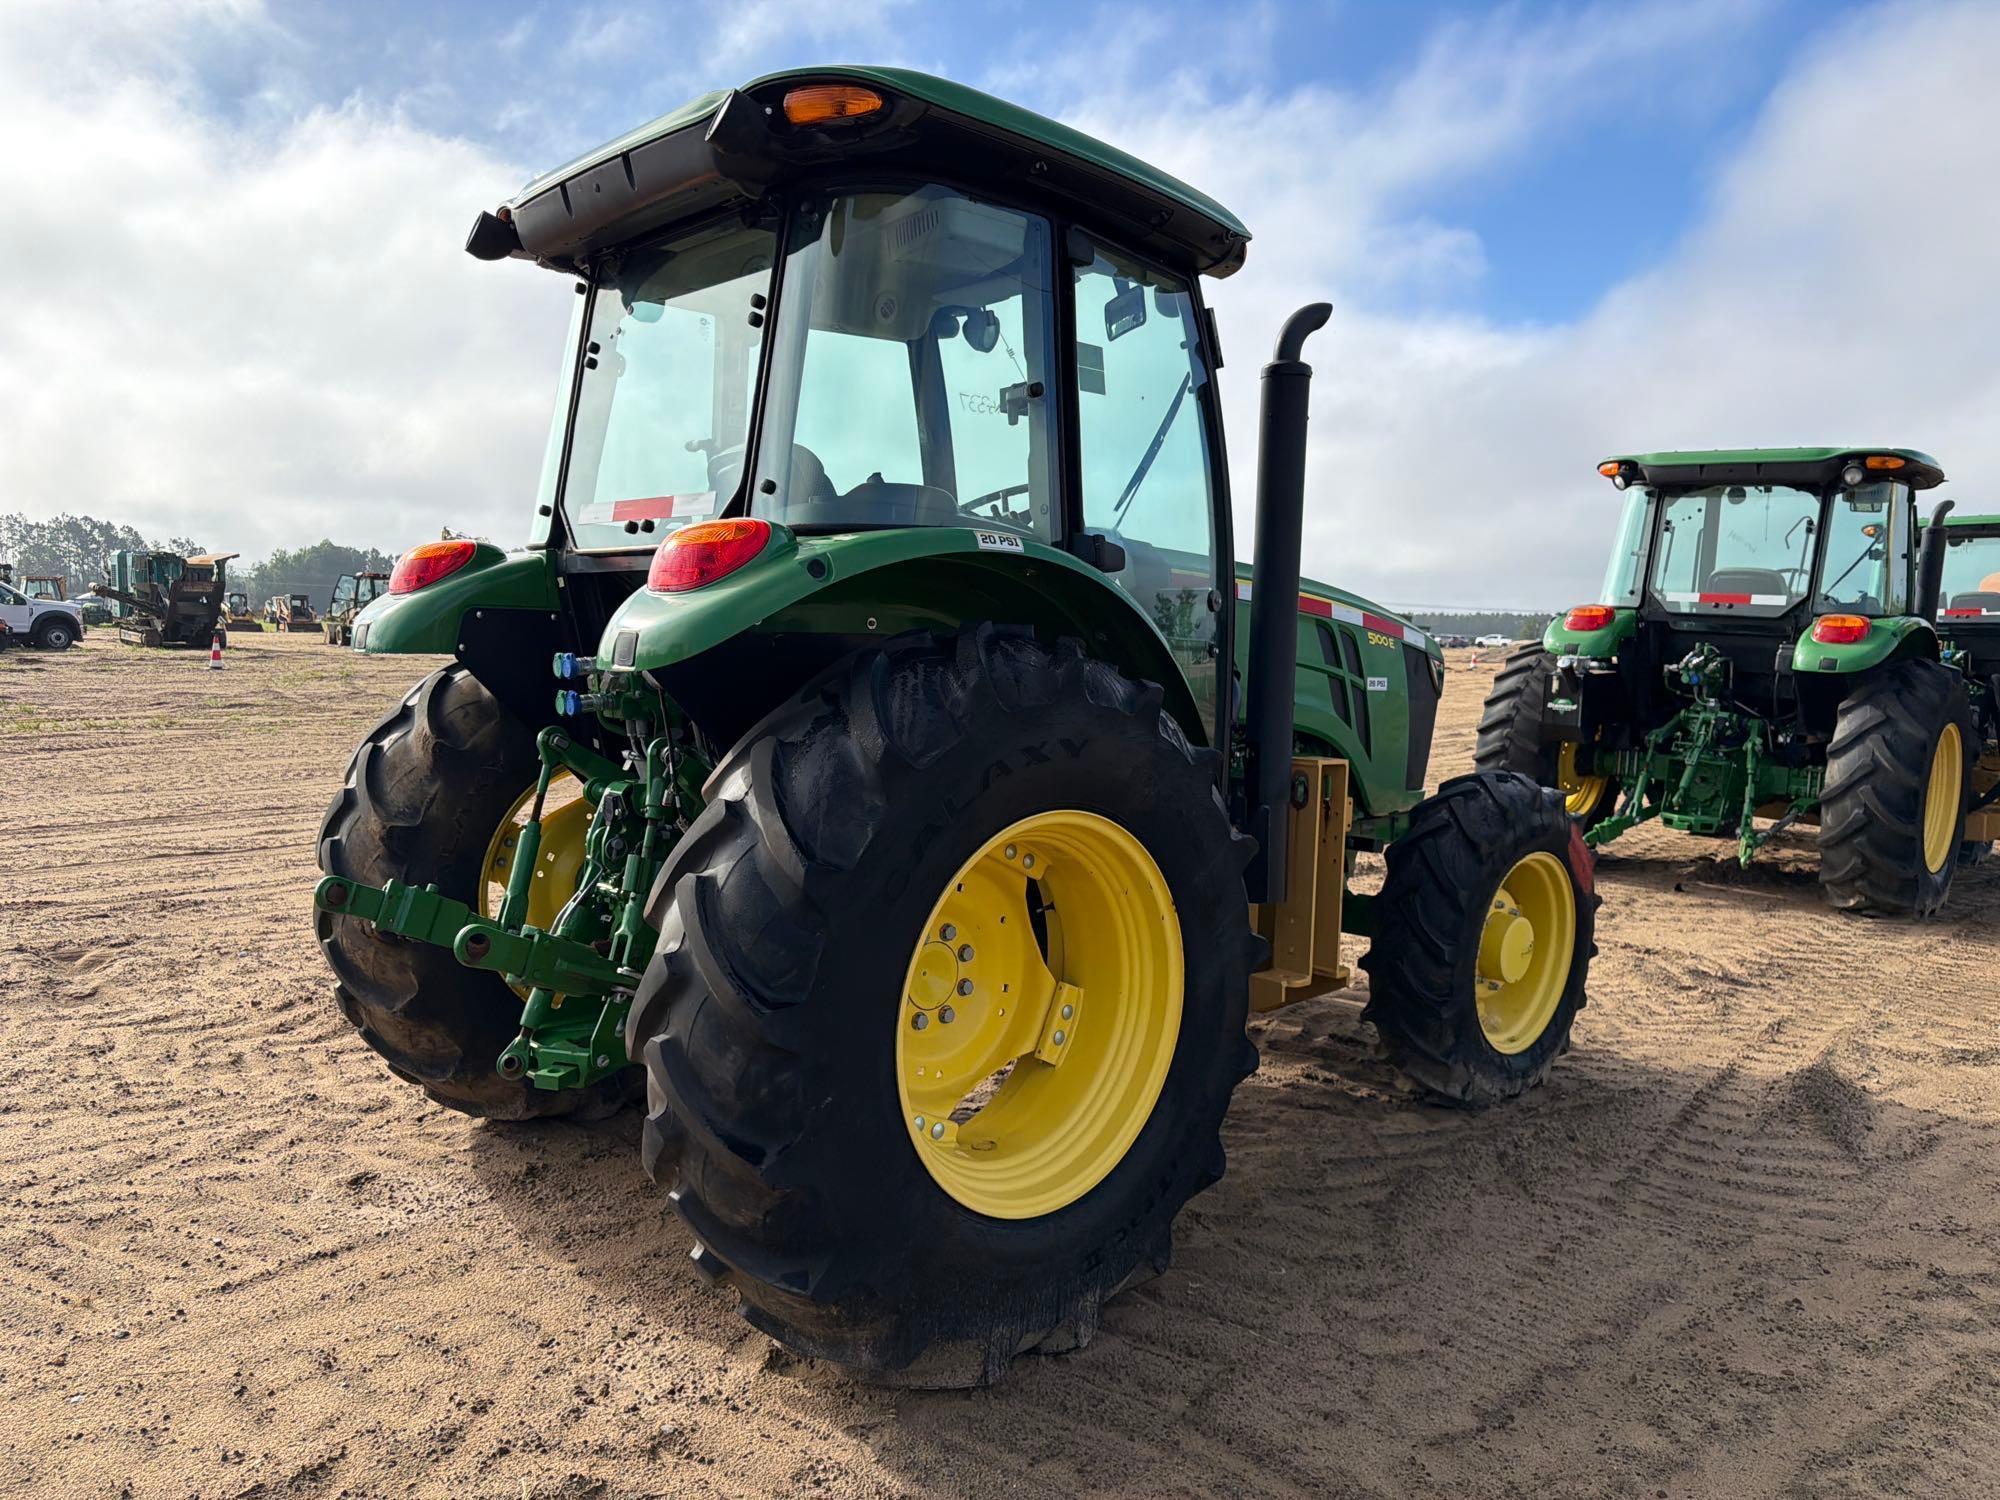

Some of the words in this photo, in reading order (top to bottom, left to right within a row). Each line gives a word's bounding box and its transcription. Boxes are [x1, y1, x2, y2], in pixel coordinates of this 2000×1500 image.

[980, 534, 997, 545] 20
[998, 535, 1020, 547] PSI
[1376, 680, 1386, 688] PSI
